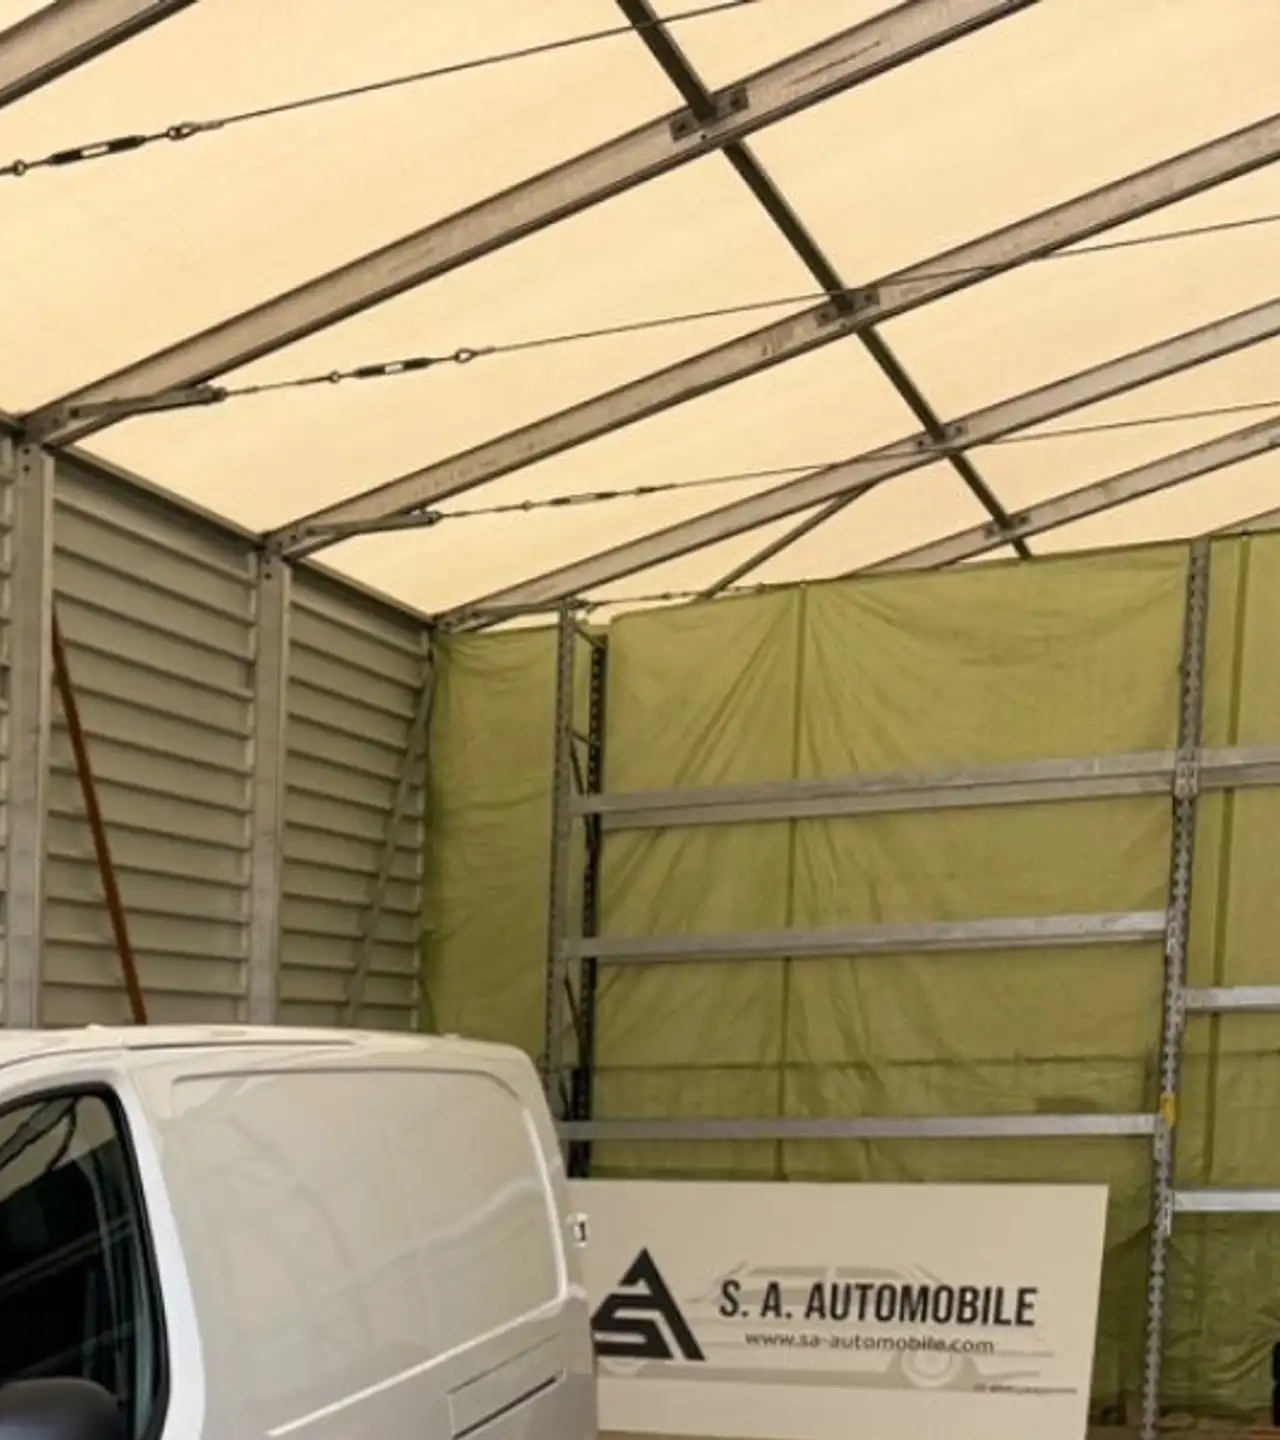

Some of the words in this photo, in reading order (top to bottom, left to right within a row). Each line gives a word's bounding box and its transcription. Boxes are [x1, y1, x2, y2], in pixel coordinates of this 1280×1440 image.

[718, 1279, 749, 1318] S.
[760, 1281, 793, 1320] A.
[804, 1282, 1038, 1327] AUTOMOBILE
[744, 1332, 995, 1355] www.sa-automobile.com
